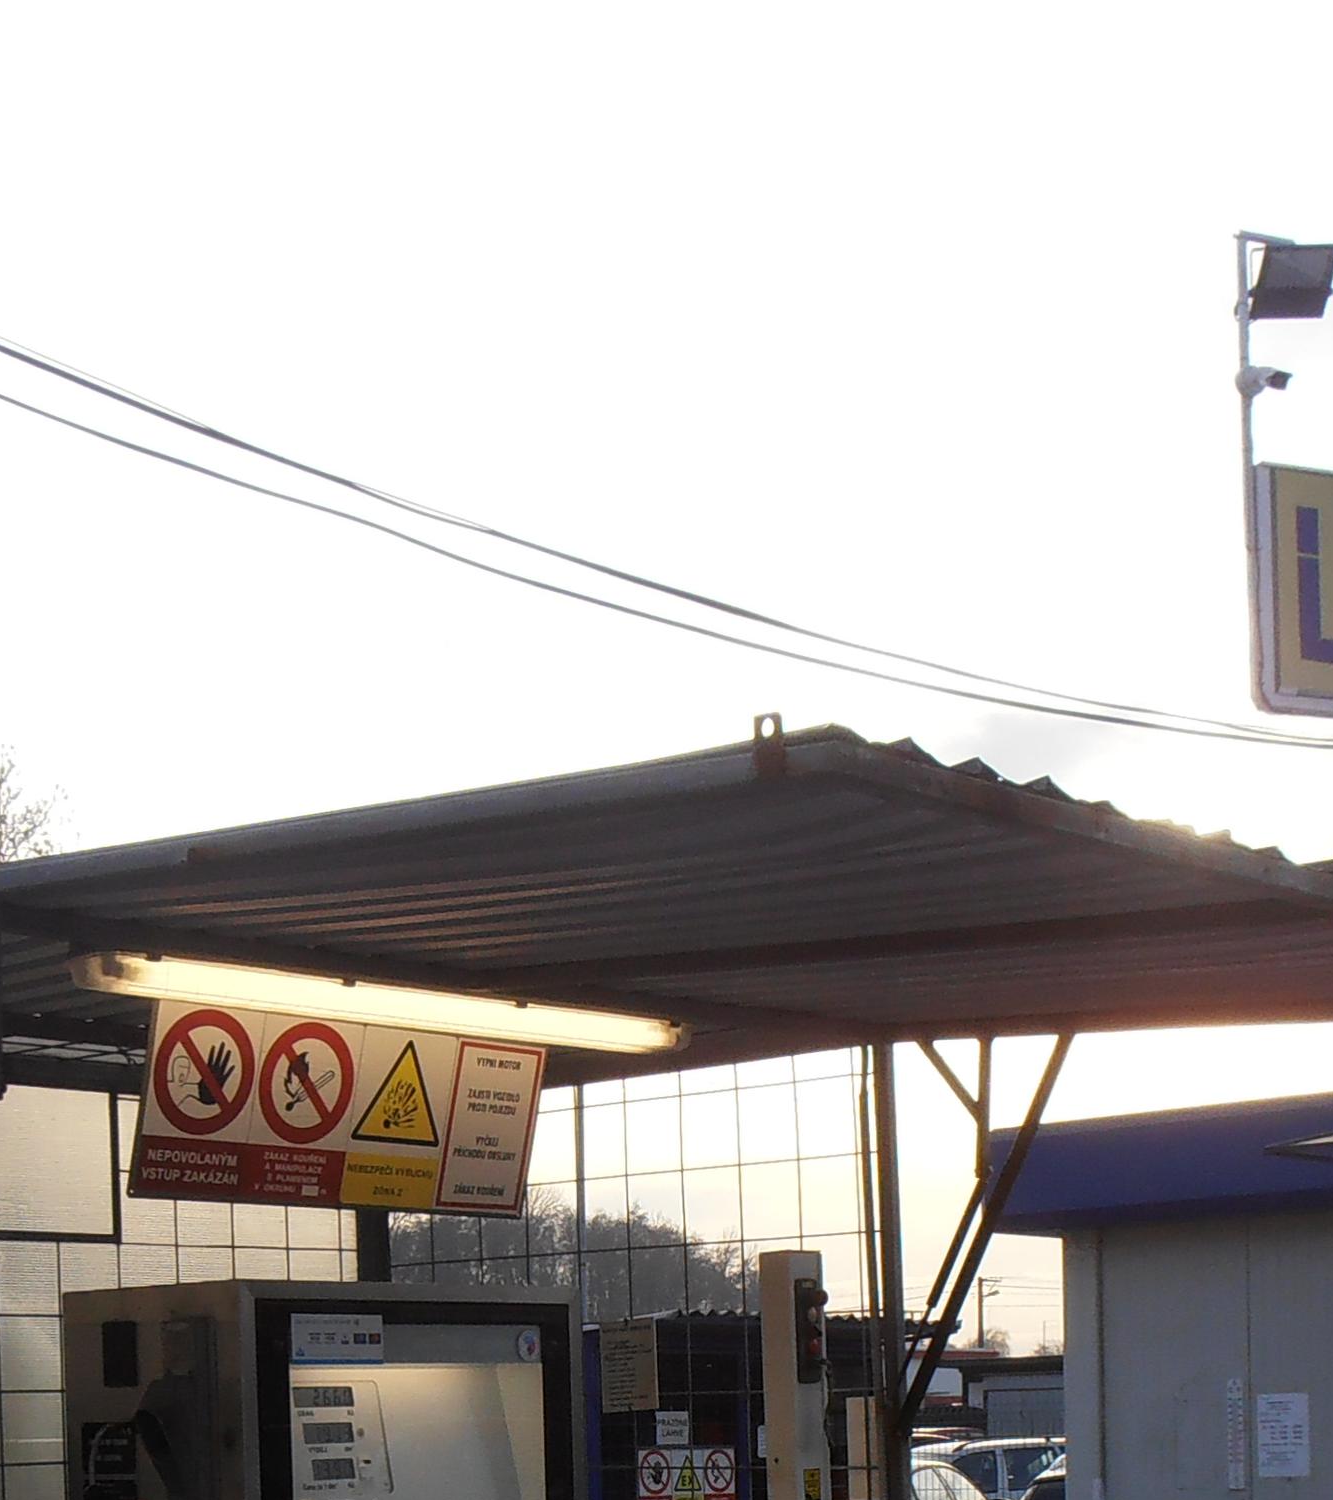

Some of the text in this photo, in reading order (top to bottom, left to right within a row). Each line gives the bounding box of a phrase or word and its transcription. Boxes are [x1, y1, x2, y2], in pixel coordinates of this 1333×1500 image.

[498, 1059, 522, 1071] MOTOR
[146, 1148, 238, 1167] NEPOVOLANÝM
[141, 1167, 181, 1183] VSTUP
